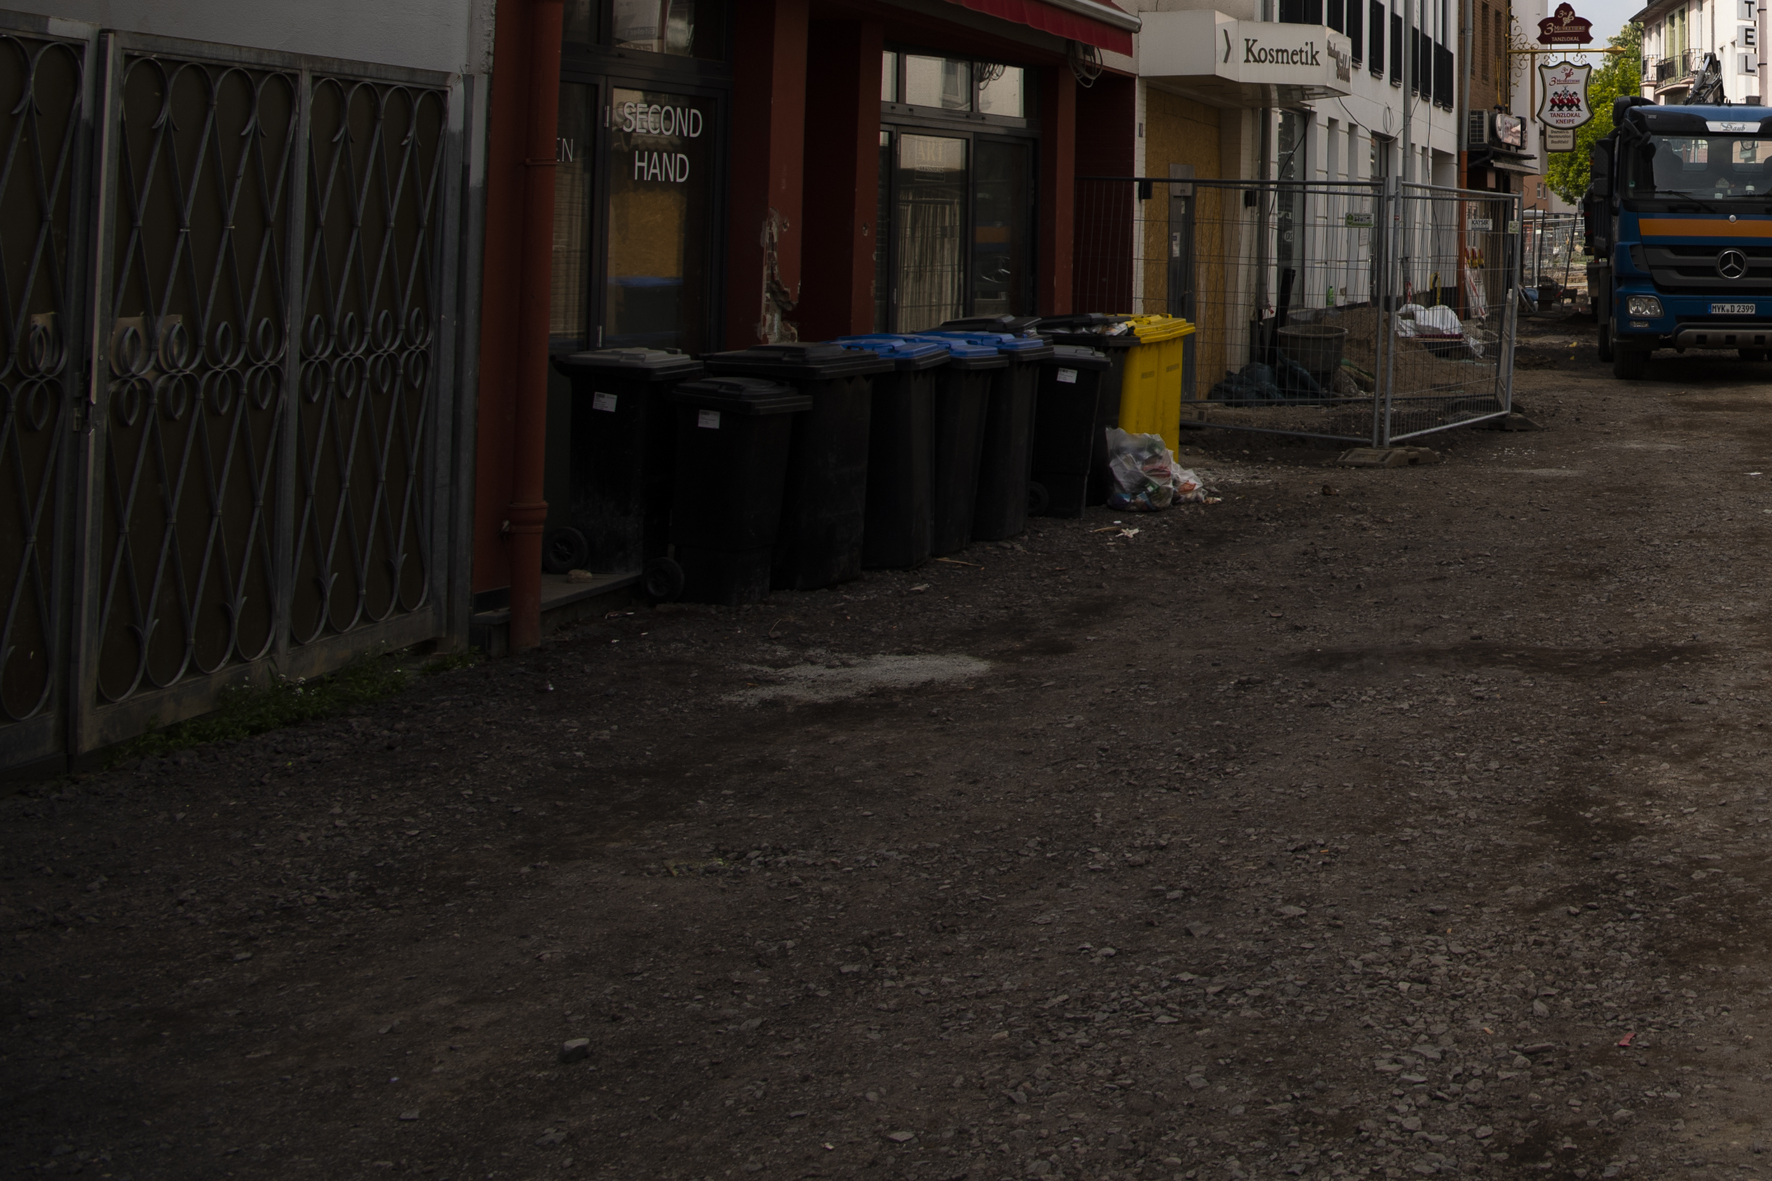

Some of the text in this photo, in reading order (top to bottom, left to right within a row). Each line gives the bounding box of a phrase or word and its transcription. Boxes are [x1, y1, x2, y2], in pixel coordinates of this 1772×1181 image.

[1544, 22, 1554, 35] 3
[1244, 38, 1321, 67] Kosmetik
[1549, 77, 1557, 86] 3
[622, 102, 704, 138] SECOND
[634, 150, 690, 183] HAND
[1712, 305, 1754, 313] MYK D 2399
